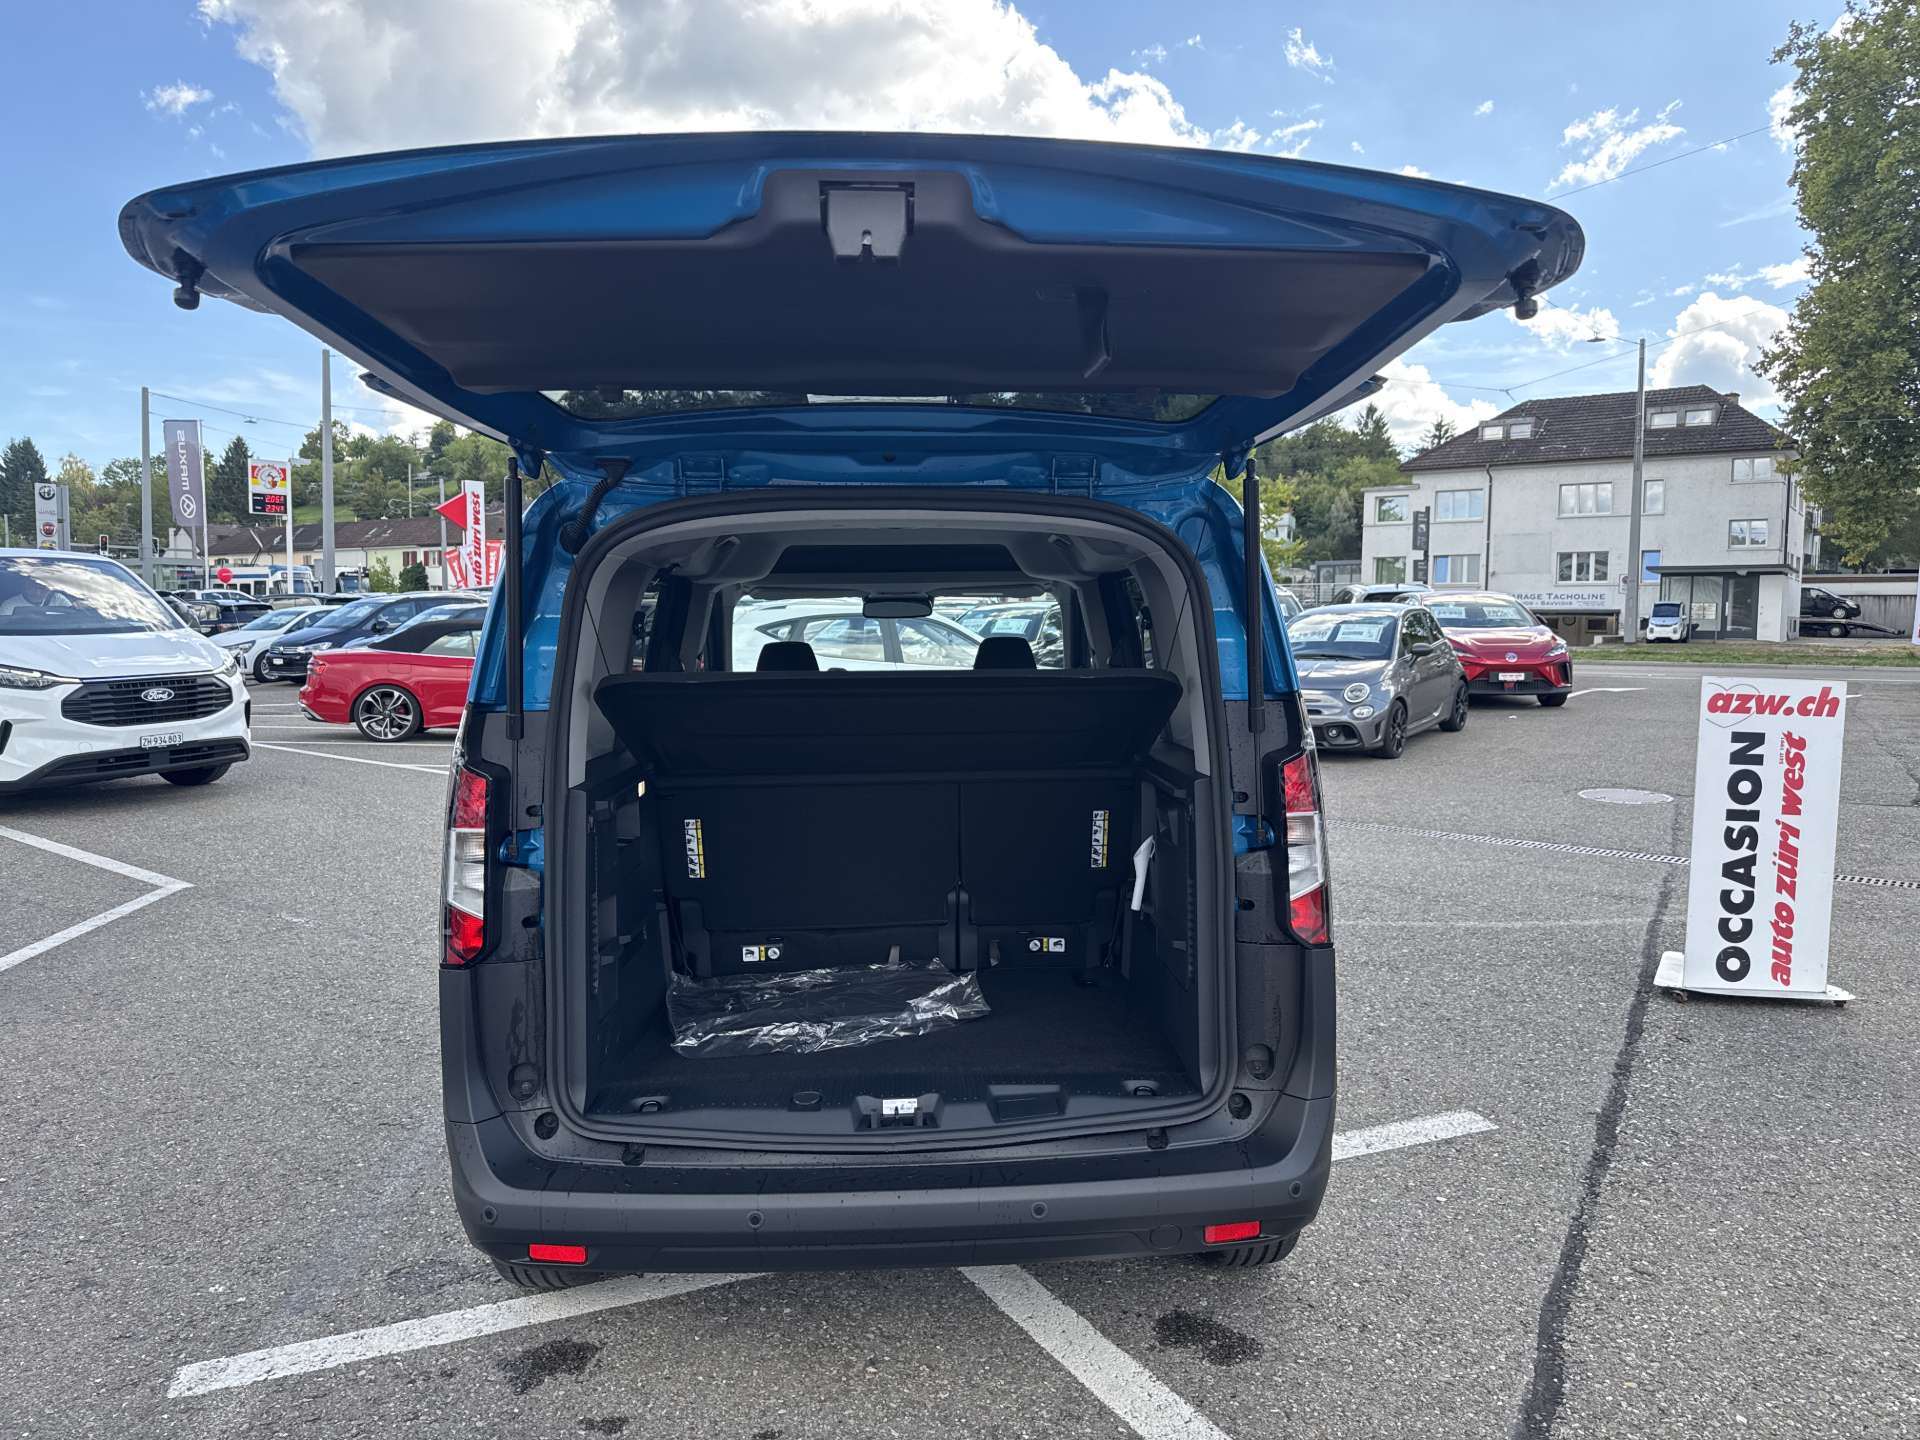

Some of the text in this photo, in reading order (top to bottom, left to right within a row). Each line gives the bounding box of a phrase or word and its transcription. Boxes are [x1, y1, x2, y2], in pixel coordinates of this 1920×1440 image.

[472, 491, 481, 526] west
[1707, 686, 1841, 718] azw.ch
[142, 737, 152, 747] ZH
[1715, 731, 1766, 983] OCCASION
[1769, 730, 1808, 987] auto züri west
